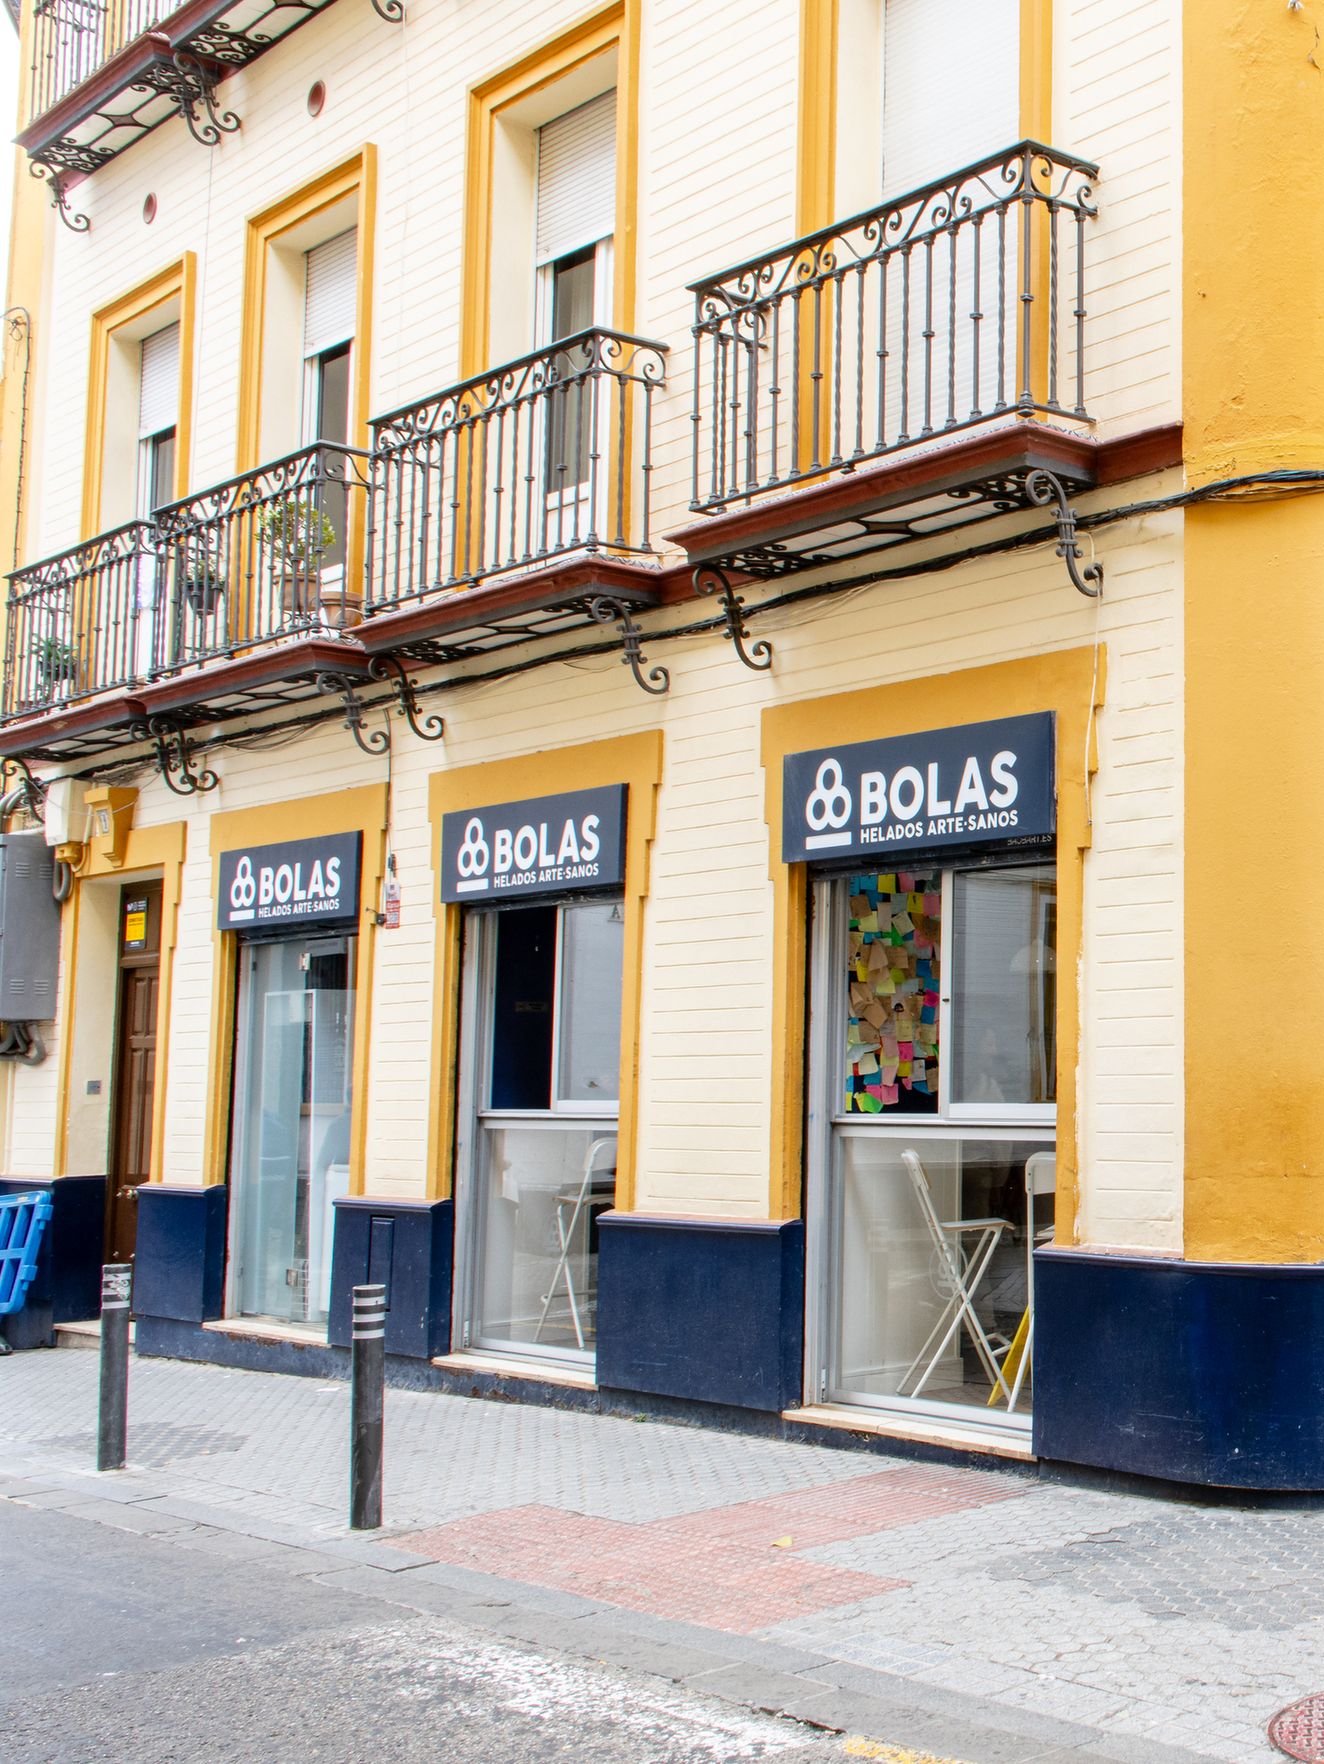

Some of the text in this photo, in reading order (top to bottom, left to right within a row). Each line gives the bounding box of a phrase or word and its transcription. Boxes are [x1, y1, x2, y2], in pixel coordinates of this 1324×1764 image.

[860, 750, 1019, 826] BOLAS
[494, 814, 600, 874] BOLAS
[861, 821, 923, 844] HELADOS
[258, 856, 341, 906] BOLAS
[494, 871, 536, 889] HELADOS
[258, 903, 291, 919] HELADOS
